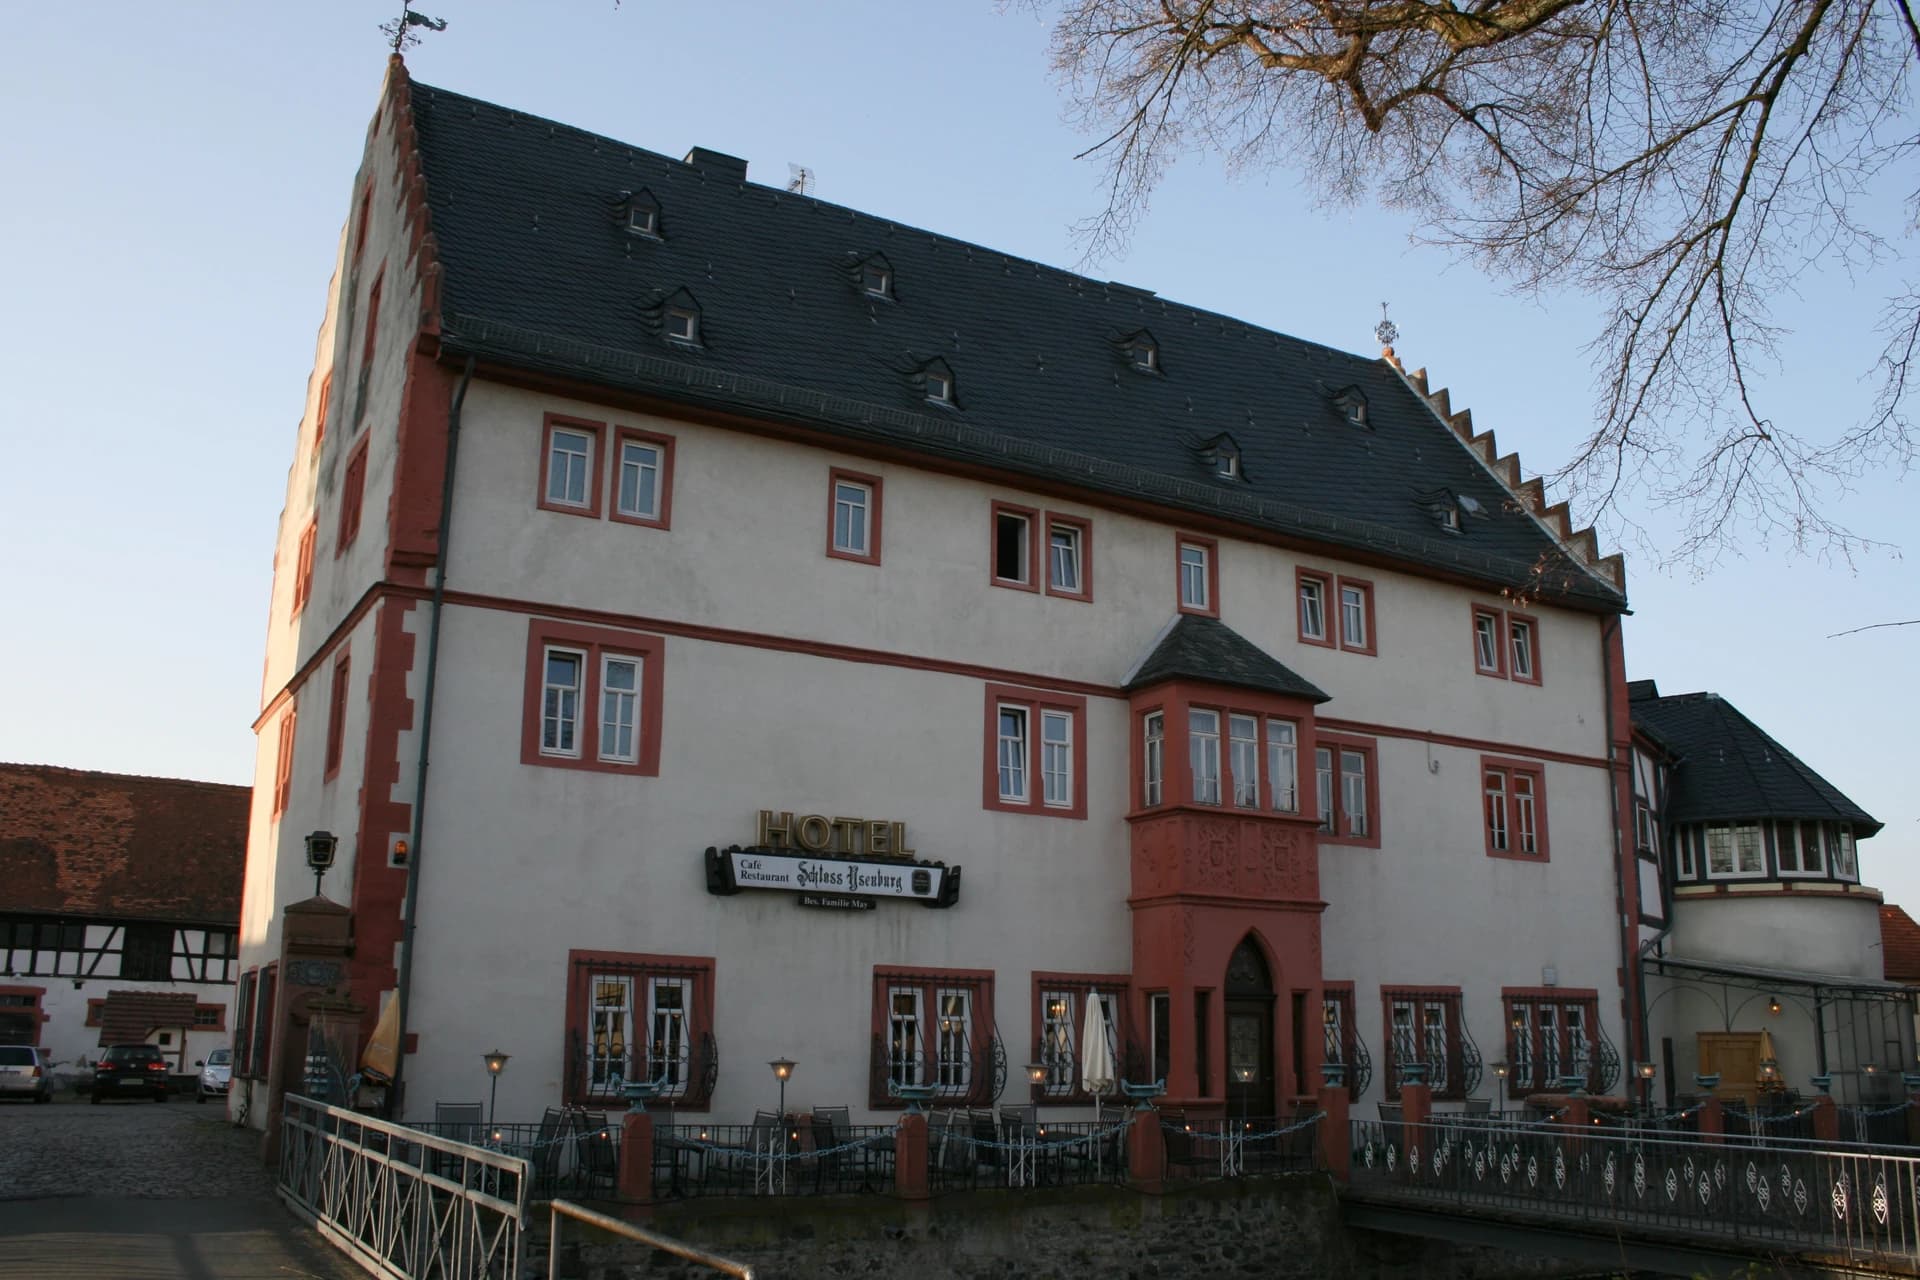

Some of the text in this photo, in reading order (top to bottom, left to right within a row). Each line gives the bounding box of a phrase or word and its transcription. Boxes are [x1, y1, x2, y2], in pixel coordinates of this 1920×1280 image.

[757, 809, 915, 859] HOTEL
[740, 859, 762, 871] Café
[740, 870, 790, 883] Restaurant
[797, 861, 844, 889] Schloss
[846, 865, 903, 894] Ysenburg
[822, 897, 850, 908] Familie
[852, 899, 869, 910] May
